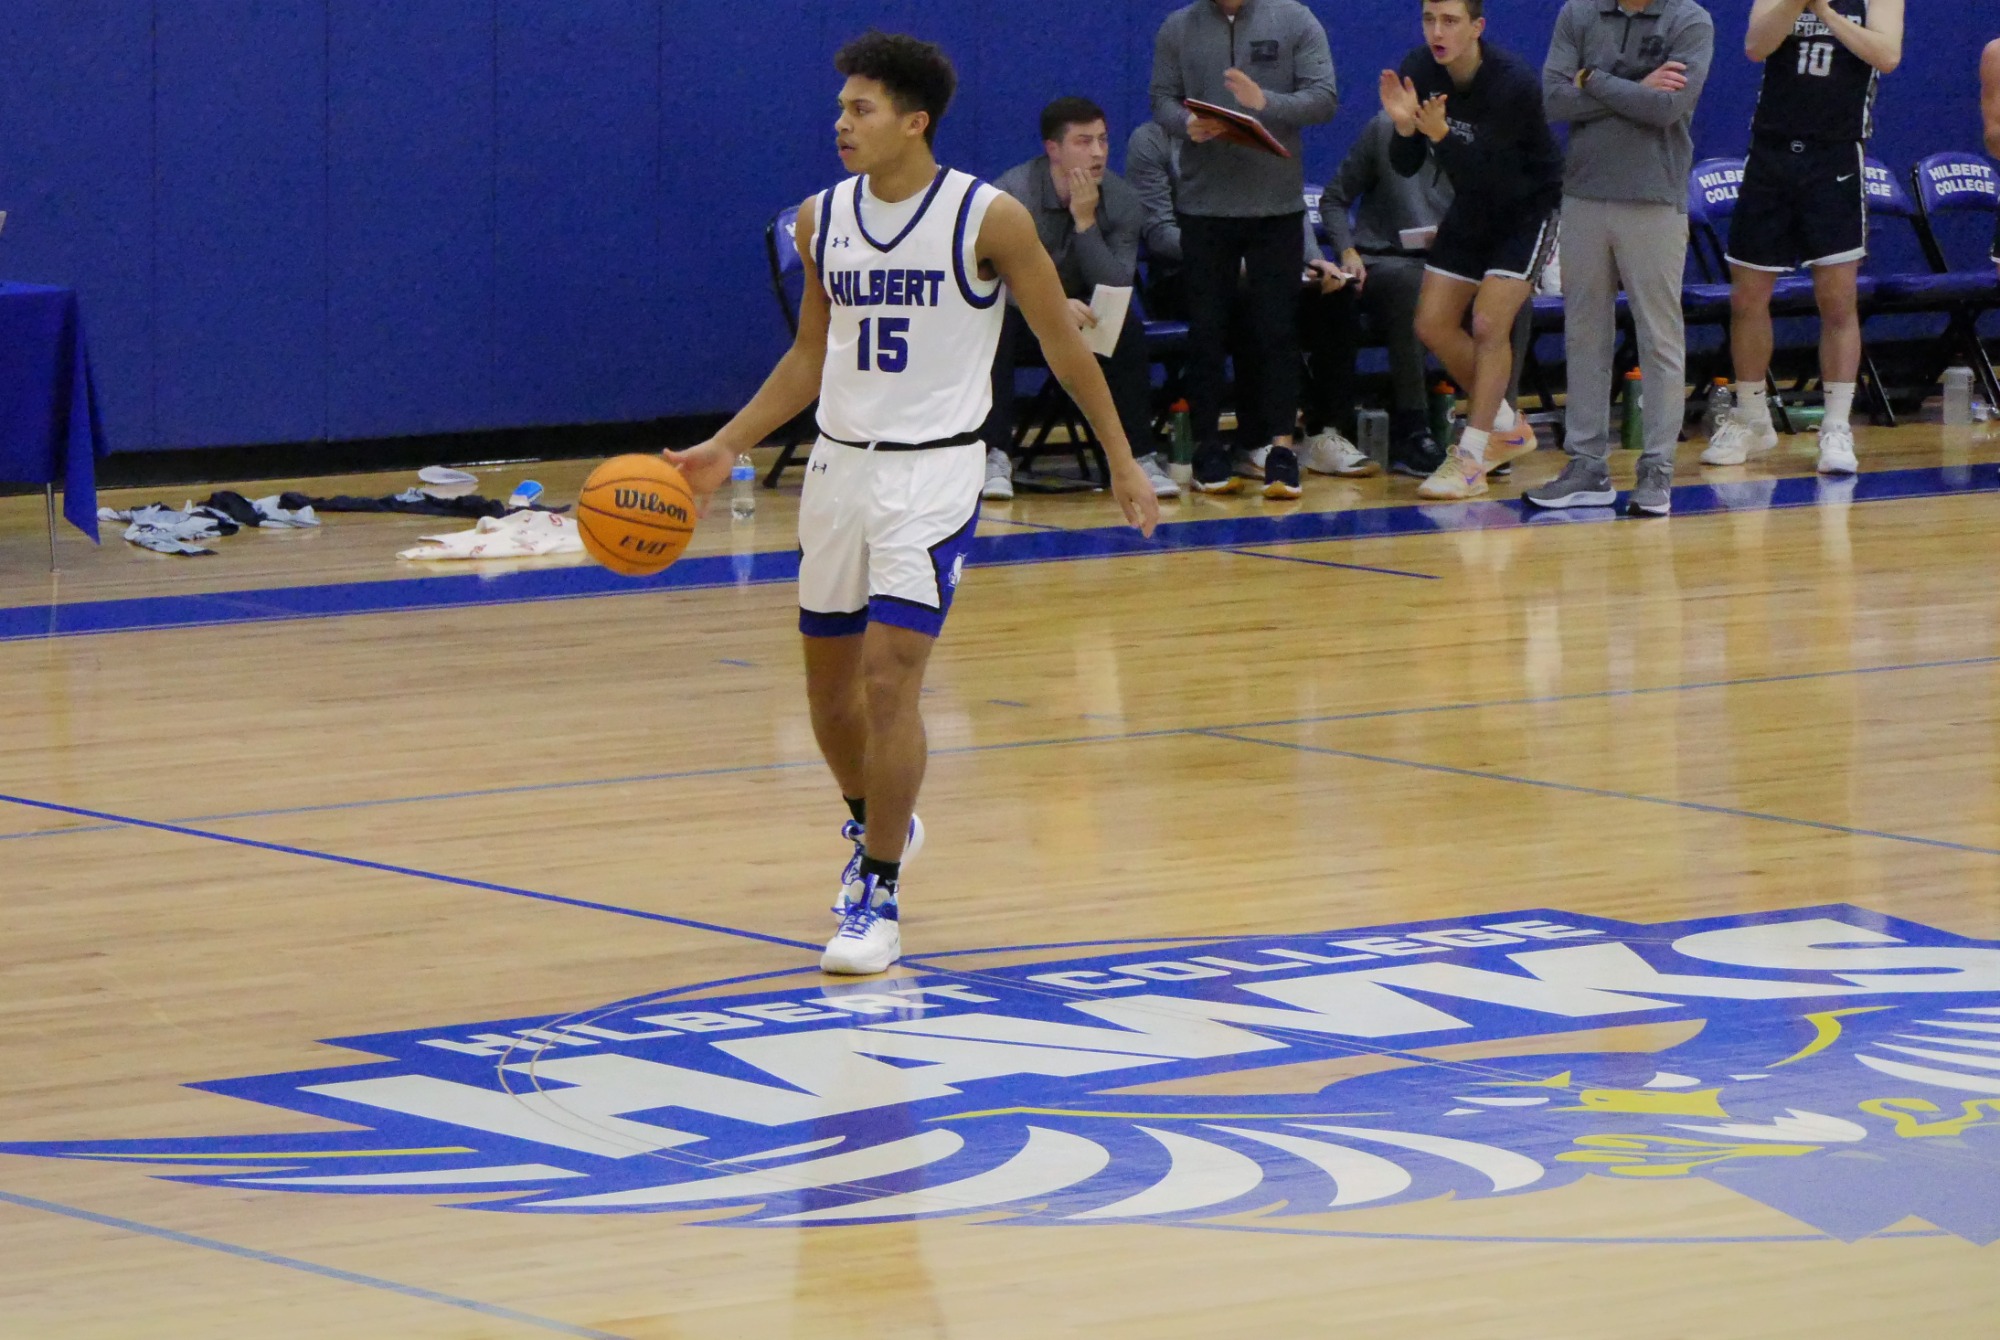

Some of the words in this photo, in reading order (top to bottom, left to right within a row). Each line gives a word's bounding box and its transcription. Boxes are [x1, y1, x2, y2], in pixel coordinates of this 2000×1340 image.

[1797, 41, 1834, 77] 10
[1928, 163, 1991, 181] HILBERT
[1935, 178, 1995, 196] COLLEGE
[829, 269, 945, 306] HILBERT
[857, 317, 910, 373] 15
[614, 488, 688, 523] Wilson
[415, 983, 1001, 1057] HILBERT
[1026, 920, 1606, 990] COLLEGE
[295, 917, 2000, 1160] HAWKS
